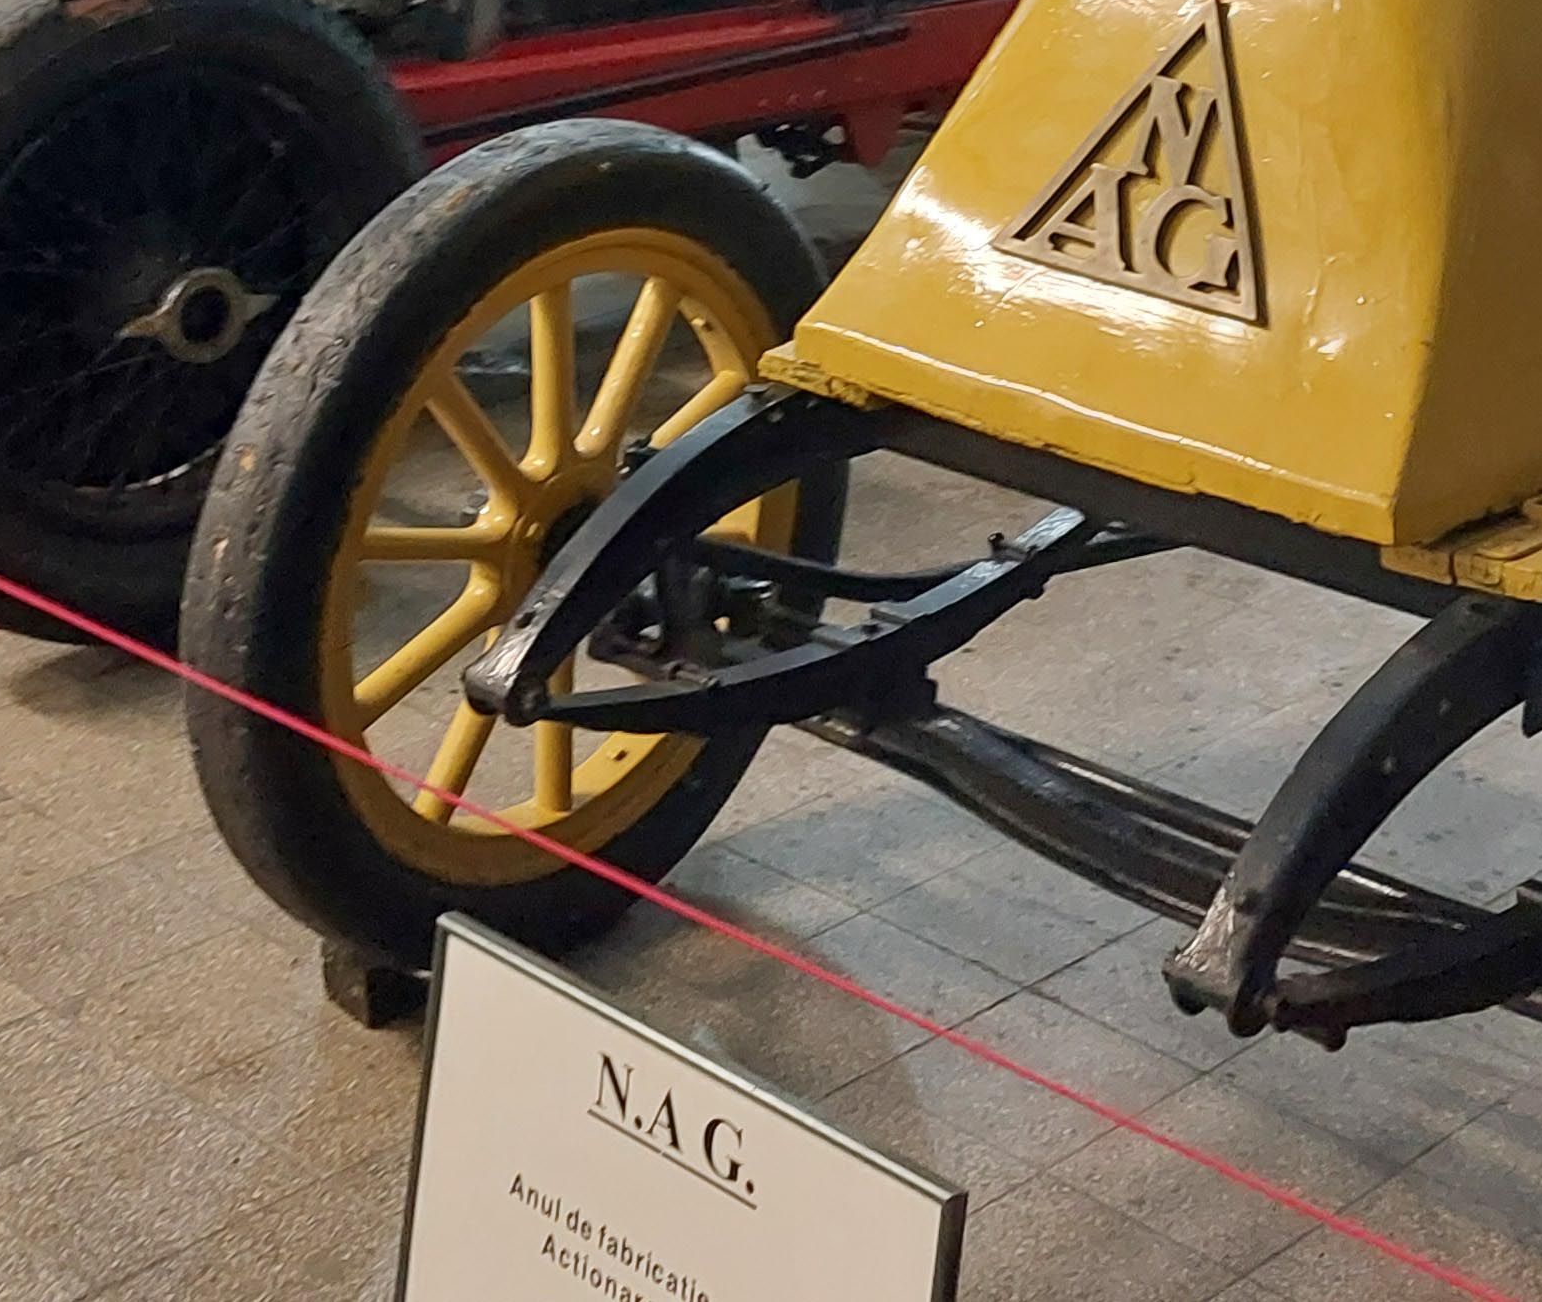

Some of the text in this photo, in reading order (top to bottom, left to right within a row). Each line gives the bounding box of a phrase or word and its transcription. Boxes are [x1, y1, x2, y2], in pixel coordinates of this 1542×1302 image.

[509, 1172, 562, 1223] Anul
[566, 1208, 593, 1240] de
[541, 1233, 653, 1302] Actiona
